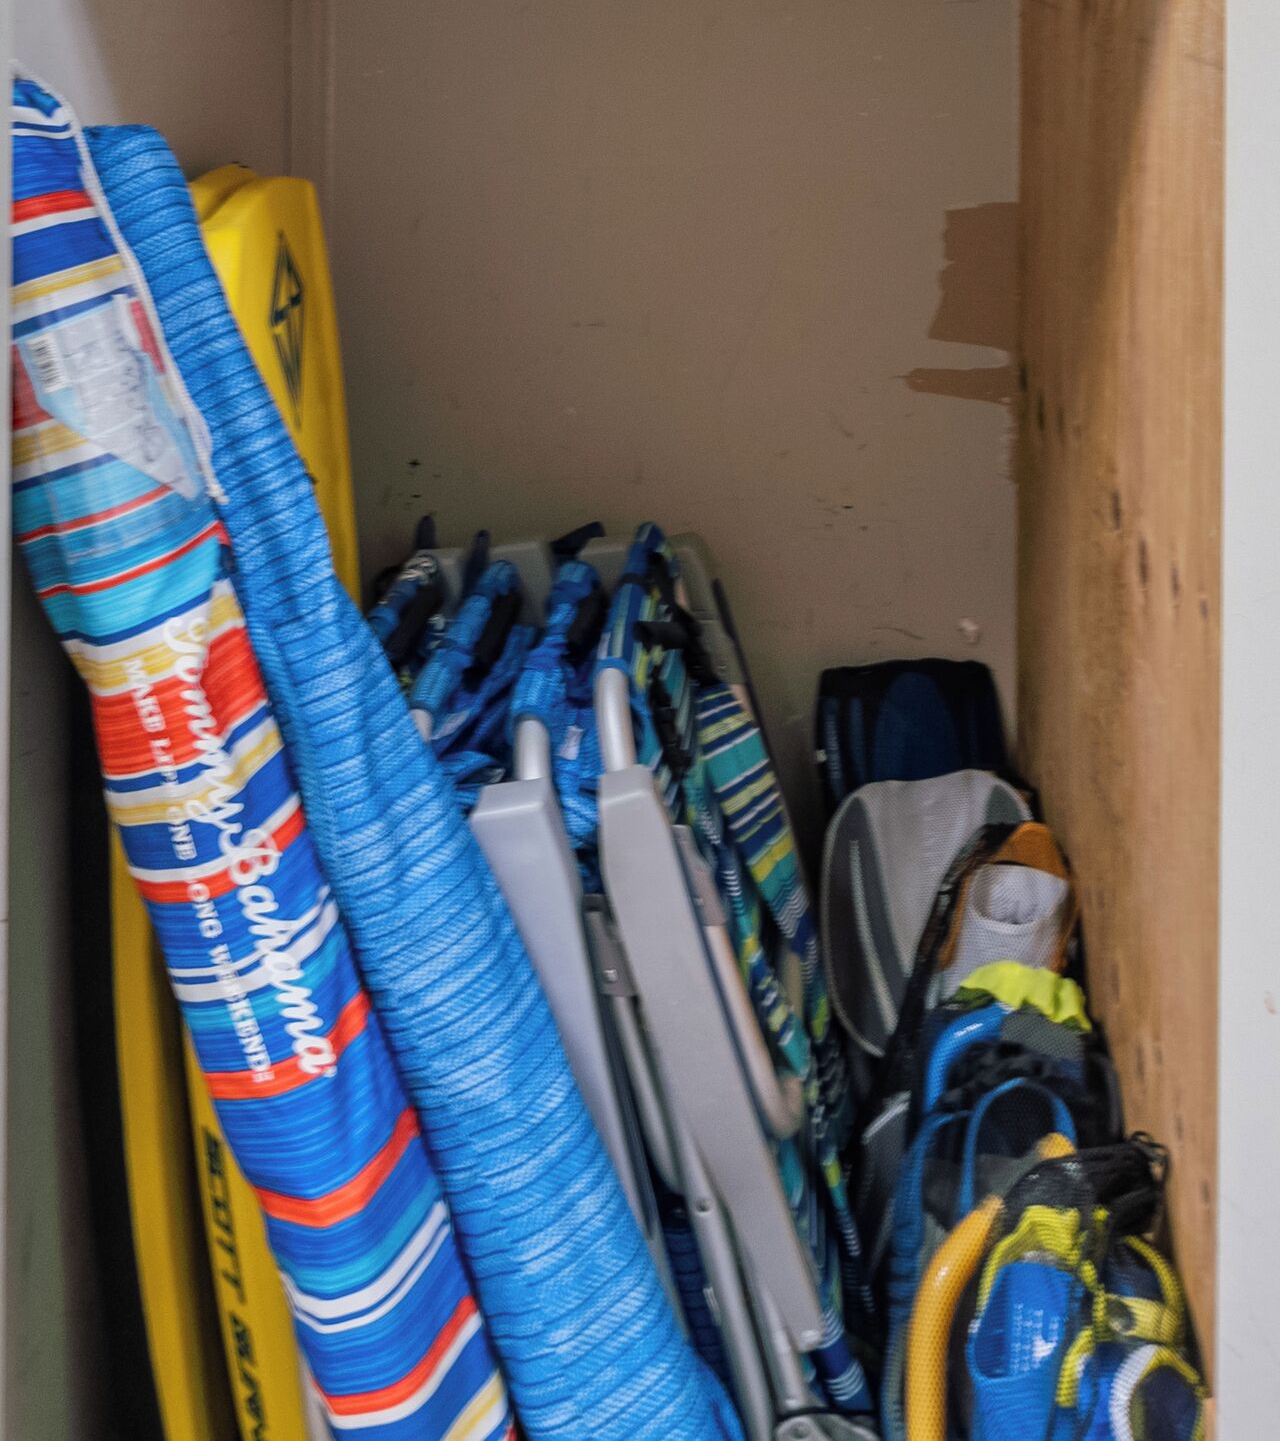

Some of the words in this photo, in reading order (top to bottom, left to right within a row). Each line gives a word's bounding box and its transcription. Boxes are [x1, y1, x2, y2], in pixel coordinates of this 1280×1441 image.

[123, 657, 166, 733] MAKE
[162, 615, 242, 844] Tommy
[218, 825, 336, 1077] Bahama
[203, 1128, 247, 1306] SCOTT
